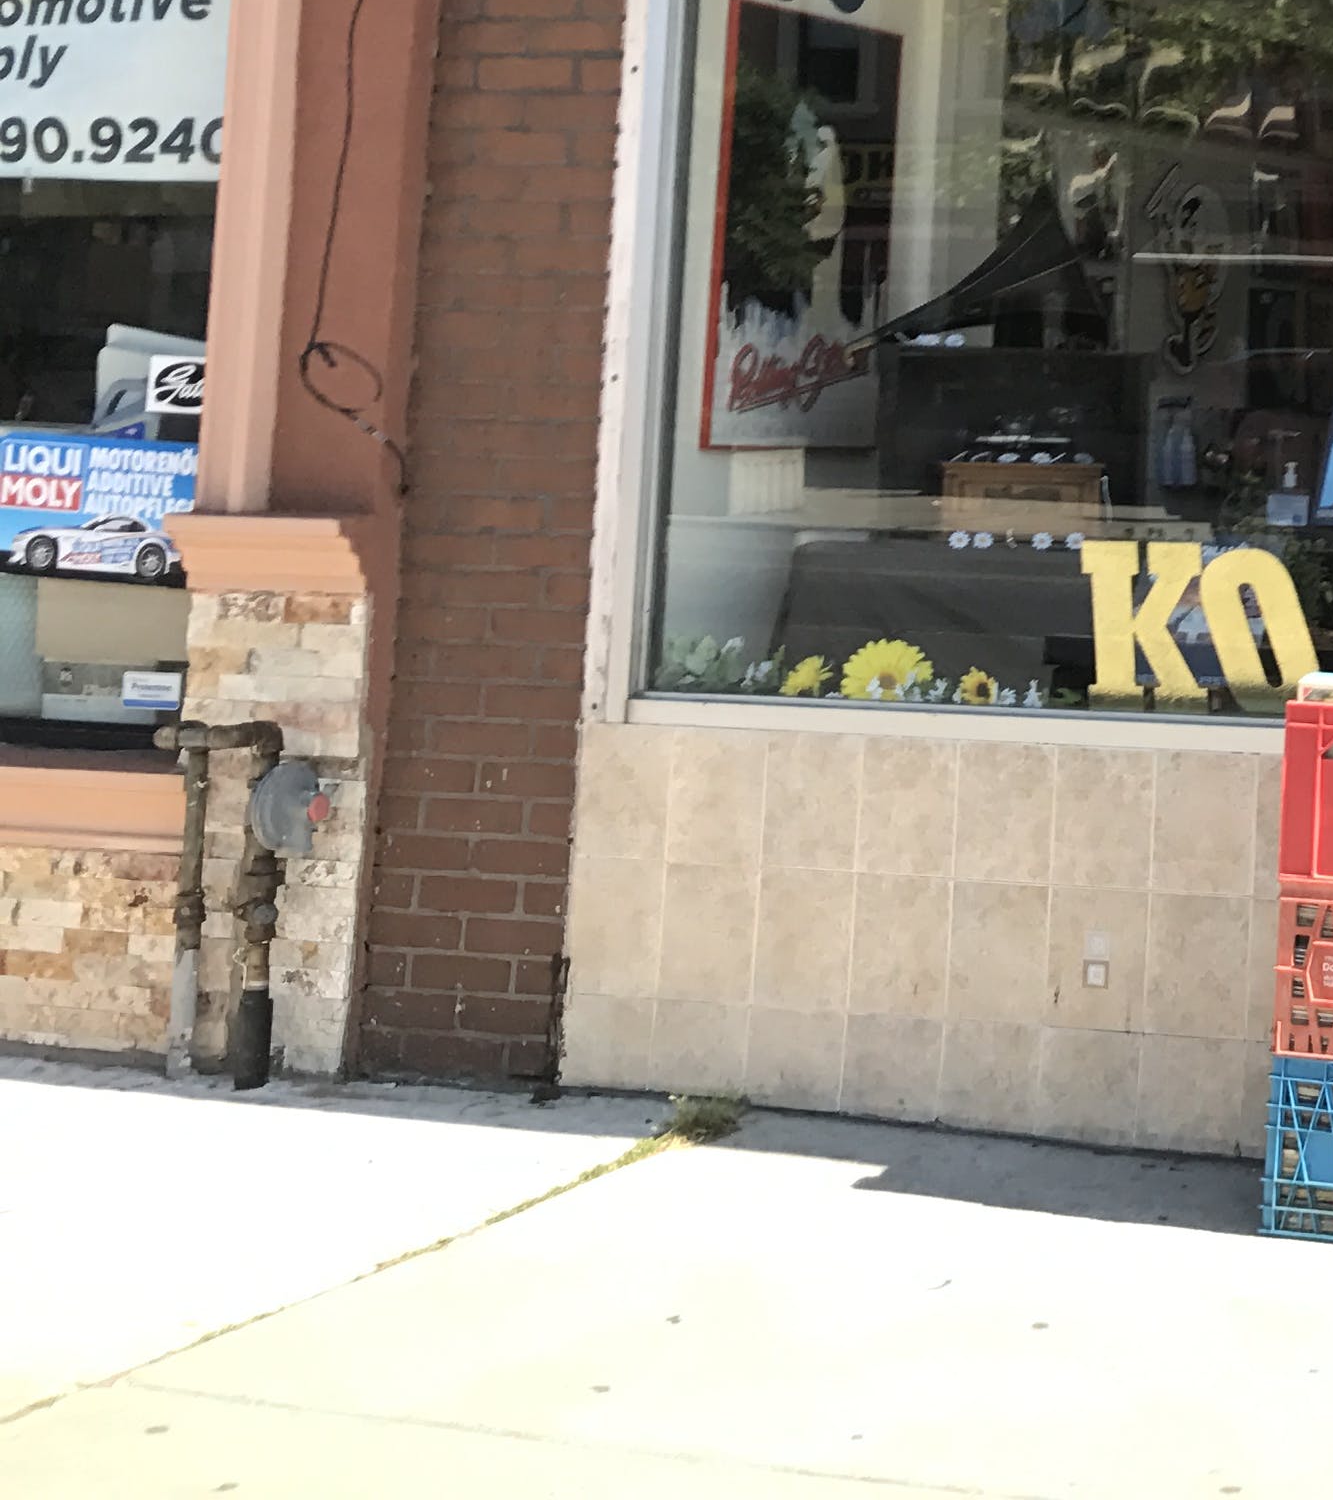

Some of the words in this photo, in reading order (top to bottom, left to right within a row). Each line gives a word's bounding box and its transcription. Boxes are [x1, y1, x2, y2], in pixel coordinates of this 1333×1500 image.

[4, 444, 82, 476] LIQUI
[1, 477, 82, 508] MOLY
[86, 470, 174, 497] ADDITIVE
